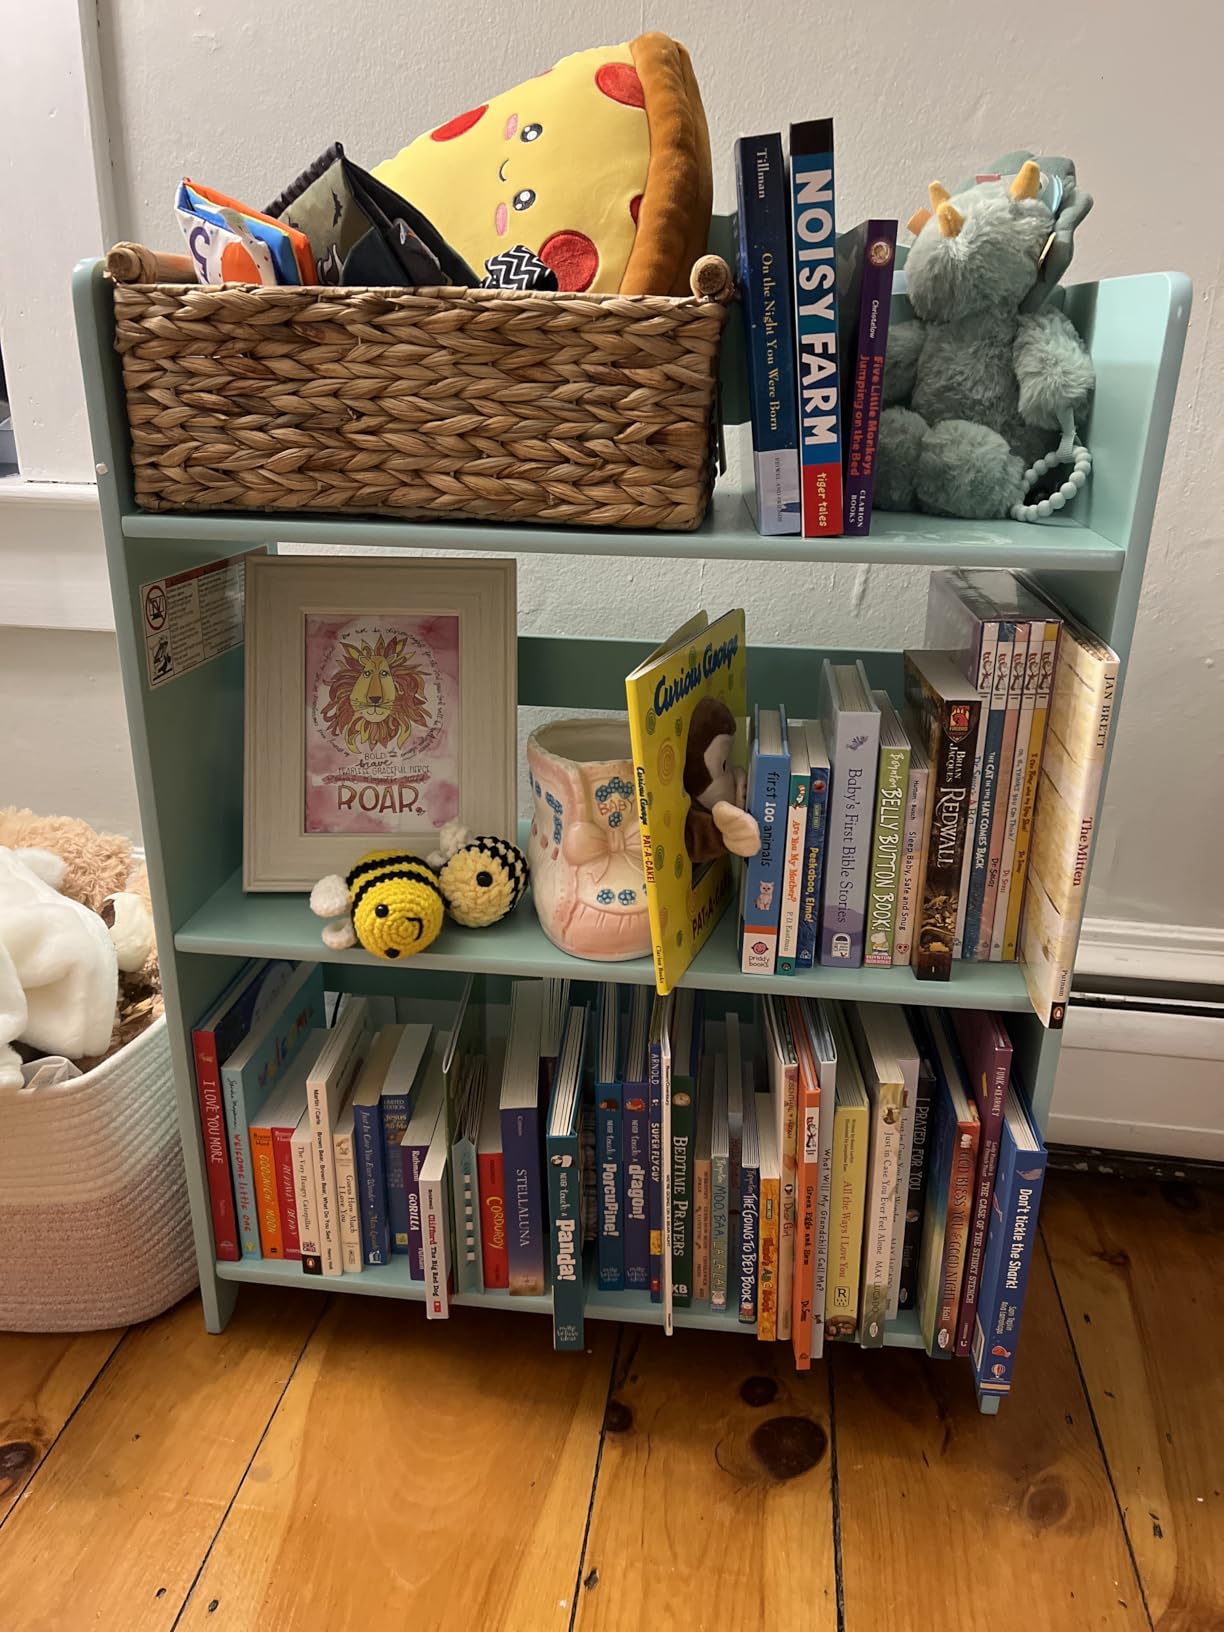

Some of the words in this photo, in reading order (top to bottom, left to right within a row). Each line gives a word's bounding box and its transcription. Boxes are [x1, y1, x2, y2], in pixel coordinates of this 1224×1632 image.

[754, 147, 771, 198] Tillman
[793, 168, 837, 321] NOISY
[761, 251, 774, 273] On
[762, 277, 776, 297] the
[761, 300, 778, 335] Night
[765, 339, 778, 364] You
[870, 355, 882, 382] Five
[766, 367, 779, 397] Were
[799, 332, 840, 444] FARM
[854, 353, 869, 409] Jumping
[867, 384, 880, 420] Little
[768, 400, 782, 431] Born
[854, 411, 862, 427] on
[851, 429, 863, 450] the
[861, 419, 876, 475] Monkeys
[849, 452, 861, 476] Bed
[816, 472, 828, 499] tiger
[817, 501, 828, 527] tales
[848, 494, 857, 523] BOOKS
[855, 489, 866, 527] CLARION
[654, 663, 702, 717] Curious
[702, 634, 739, 679] George
[1100, 673, 1115, 700] JAN
[1095, 704, 1110, 748] BRETT
[354, 759, 394, 768] brave
[364, 752, 386, 760] BOLD
[943, 742, 958, 782] JACQUES
[953, 749, 965, 779] BRIAN
[987, 751, 995, 762] THE
[372, 766, 407, 776] GRACEFUL
[886, 751, 904, 788] Boynton
[984, 763, 994, 779] CAT
[636, 766, 646, 797] Curious
[764, 770, 780, 799] first
[842, 767, 862, 810] Baby's
[982, 788, 990, 800] THE
[637, 797, 649, 826] George
[762, 801, 776, 823] 100
[878, 787, 902, 831] BELLY
[980, 800, 989, 818] HAT
[791, 819, 801, 835] Are
[842, 813, 859, 842] First
[929, 784, 966, 870] REDWALL
[976, 817, 988, 845] COMES
[1078, 815, 1093, 843] The
[759, 824, 775, 867] animals
[790, 837, 799, 851] You
[905, 831, 916, 853] Sleep
[642, 834, 654, 884] PAT-A-CAKE!
[787, 852, 799, 866] My
[839, 845, 856, 877] Bible
[874, 832, 899, 888] BUTTON
[903, 854, 914, 876] Baby,
[974, 847, 985, 869] BACK
[1071, 842, 1088, 887] Mitten
[804, 846, 818, 895] Peekaboo,
[786, 868, 798, 903] Mother?
[902, 877, 911, 894] Safe
[804, 896, 815, 922] Elmo!
[836, 880, 853, 923] Stories
[870, 891, 894, 931] BOOK!
[901, 895, 910, 910] and
[898, 911, 908, 930] Snug
[654, 944, 663, 965] Clarion
[1057, 968, 1068, 997] Putnam
[650, 1053, 659, 1085] ARNOLD
[202, 1087, 220, 1113] LOVE
[206, 1115, 221, 1136] YOU
[912, 1105, 929, 1145] PRAYED
[208, 1136, 224, 1165] MORE
[883, 1131, 894, 1148] Just
[297, 1146, 305, 1158] The
[820, 1148, 830, 1171] What
[883, 1149, 892, 1157] in
[910, 1147, 923, 1166] FOR
[297, 1160, 305, 1173] Very
[671, 1135, 688, 1194] BEDTIME
[881, 1159, 892, 1178] Case
[298, 1175, 308, 1198] Hungry
[345, 1174, 354, 1195] Guess
[626, 1164, 646, 1220] dragon!
[820, 1174, 830, 1191] Will
[841, 1180, 853, 1194] All
[879, 1179, 889, 1195] You
[908, 1170, 921, 1191] YOU
[953, 1176, 969, 1208] BLESS
[979, 1181, 989, 1197] THE
[346, 1196, 355, 1212] How
[515, 1168, 530, 1247] STELLALUNA
[742, 1193, 757, 1209] THE
[805, 1185, 813, 1208] Green
[816, 1194, 828, 1207] My
[841, 1198, 852, 1210] the
[878, 1196, 889, 1213] Ever
[976, 1198, 986, 1218] CASE
[1016, 1187, 1034, 1214] Don't
[300, 1198, 311, 1231] Caterpillar
[407, 1192, 419, 1230] GORILLA
[485, 1196, 505, 1249] CORDUROY
[782, 1202, 793, 1220] Dear
[803, 1212, 812, 1230] Eggs
[838, 1211, 850, 1229] Ways
[951, 1209, 965, 1228] YOU
[348, 1214, 357, 1233] Much
[427, 1214, 436, 1245] Clifford
[671, 1199, 688, 1256] PRAYERS
[741, 1210, 756, 1239] GOING
[781, 1222, 792, 1238] Girl
[816, 1210, 828, 1255] Grandchild
[877, 1215, 887, 1231] Feel
[974, 1219, 984, 1230] OF
[1011, 1214, 1029, 1241] tickle
[741, 1240, 755, 1252] TO
[875, 1232, 886, 1255] Alone
[972, 1231, 982, 1246] THE
[1009, 1241, 1024, 1259] the
[838, 1241, 848, 1260] Love
[946, 1240, 961, 1268] GOOD
[968, 1247, 980, 1273] STINKY
[429, 1260, 437, 1270] Big
[740, 1253, 756, 1274] BED
[815, 1257, 825, 1273] Call
[837, 1261, 848, 1278] You
[873, 1260, 883, 1278] MAX
[1003, 1259, 1021, 1290] Shark!
[430, 1285, 439, 1297] Dog
[814, 1275, 824, 1292] Me?
[942, 1271, 957, 1302] NIGHT
[964, 1274, 976, 1304] STENCH
[870, 1280, 881, 1312] LUCADO
[941, 1306, 950, 1321] Hall
